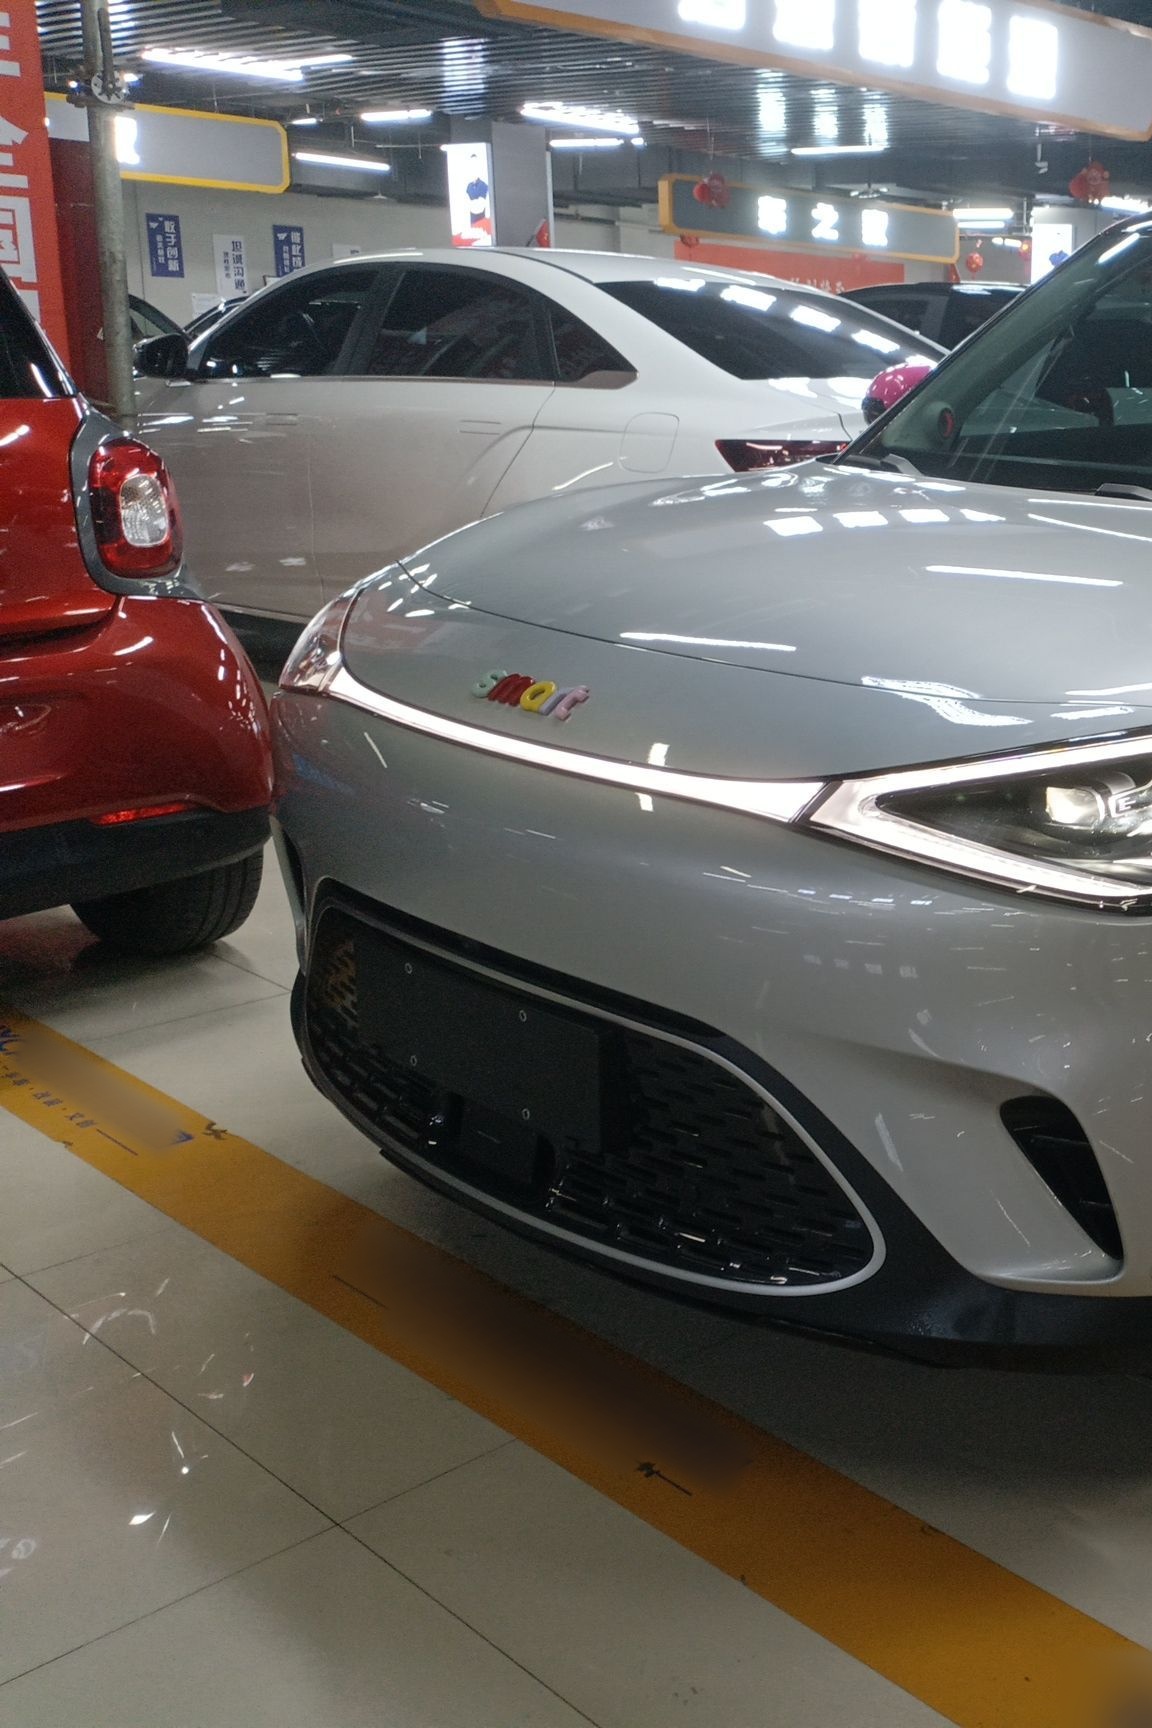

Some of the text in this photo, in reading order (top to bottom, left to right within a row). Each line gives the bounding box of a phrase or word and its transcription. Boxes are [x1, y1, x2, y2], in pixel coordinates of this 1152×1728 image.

[164, 220, 179, 272] 敢于创新
[231, 240, 245, 290] 坦诚沟通
